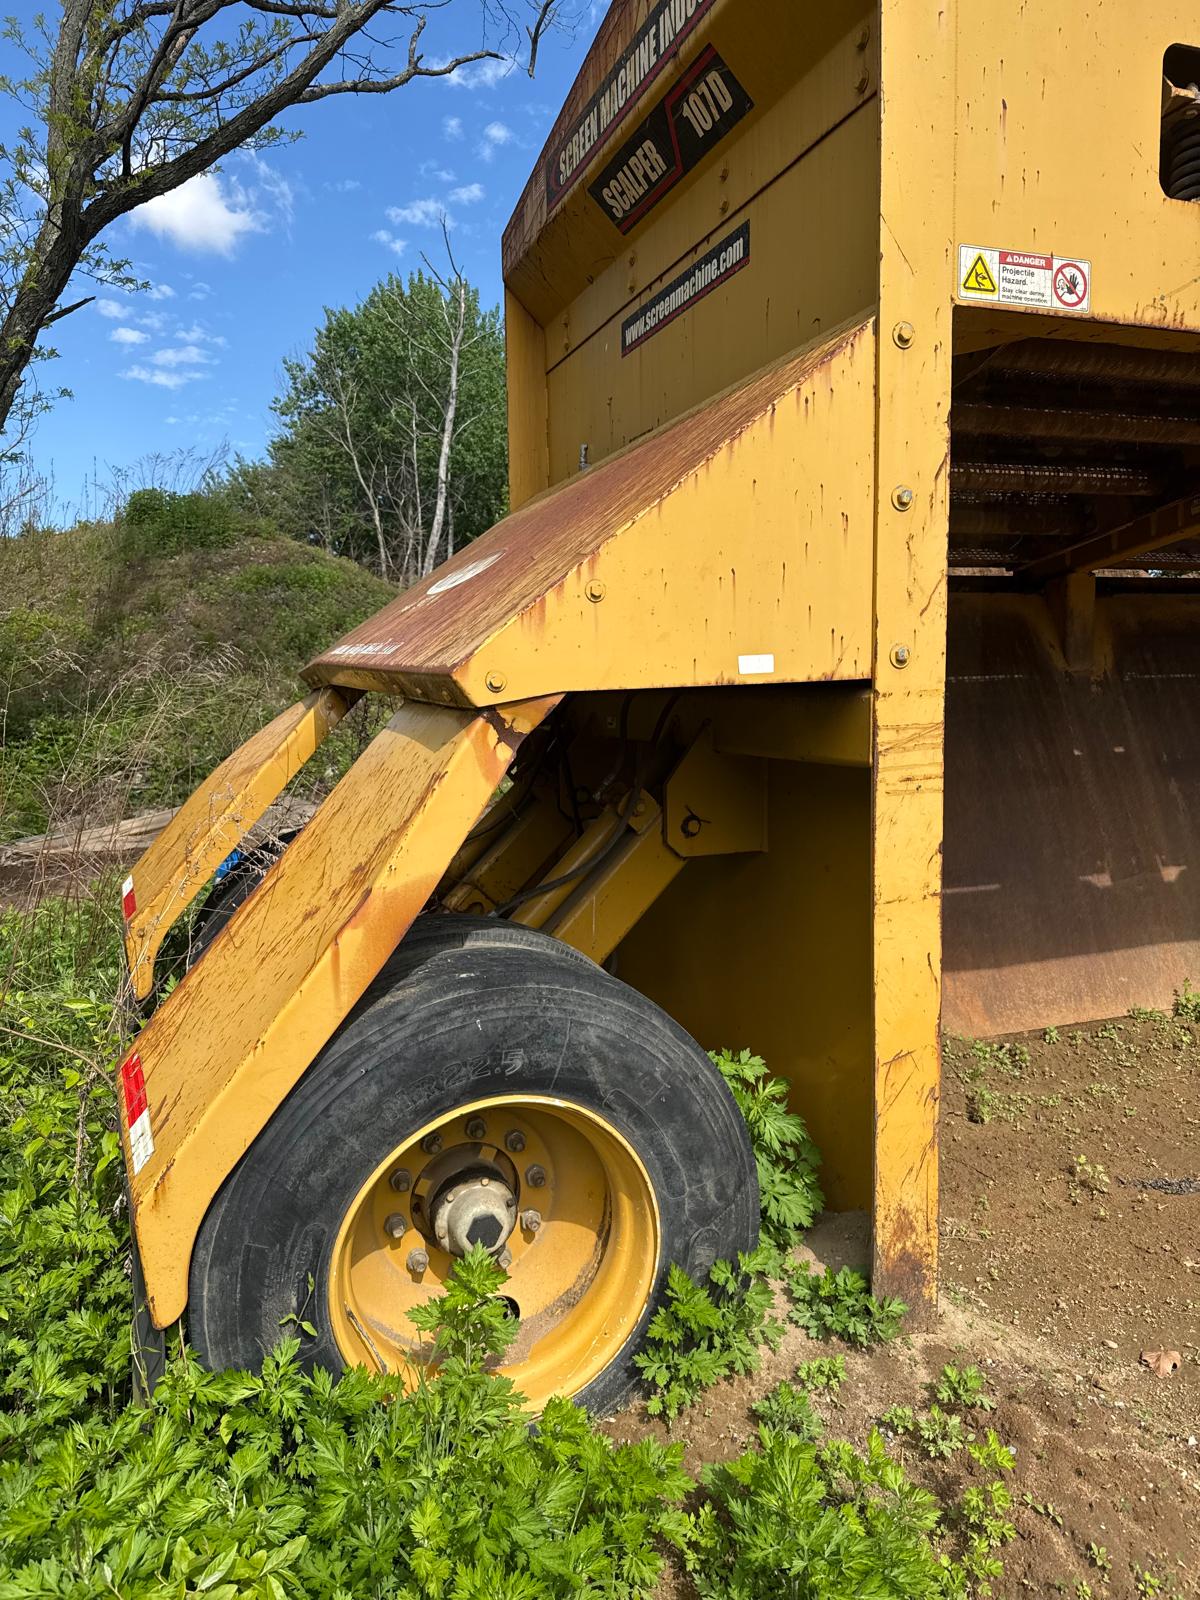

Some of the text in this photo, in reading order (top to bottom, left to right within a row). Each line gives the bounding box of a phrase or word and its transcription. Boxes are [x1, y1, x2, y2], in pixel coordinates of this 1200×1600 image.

[559, 0, 703, 185] SCREEN MACHINE INDU
[682, 70, 733, 138] 107D
[602, 139, 668, 218] SCALPER
[625, 237, 744, 346] www.screenmachine.com
[1002, 266, 1035, 277] Projectile
[1002, 276, 1028, 286] Hazard.
[1013, 255, 1046, 267] DANGER
